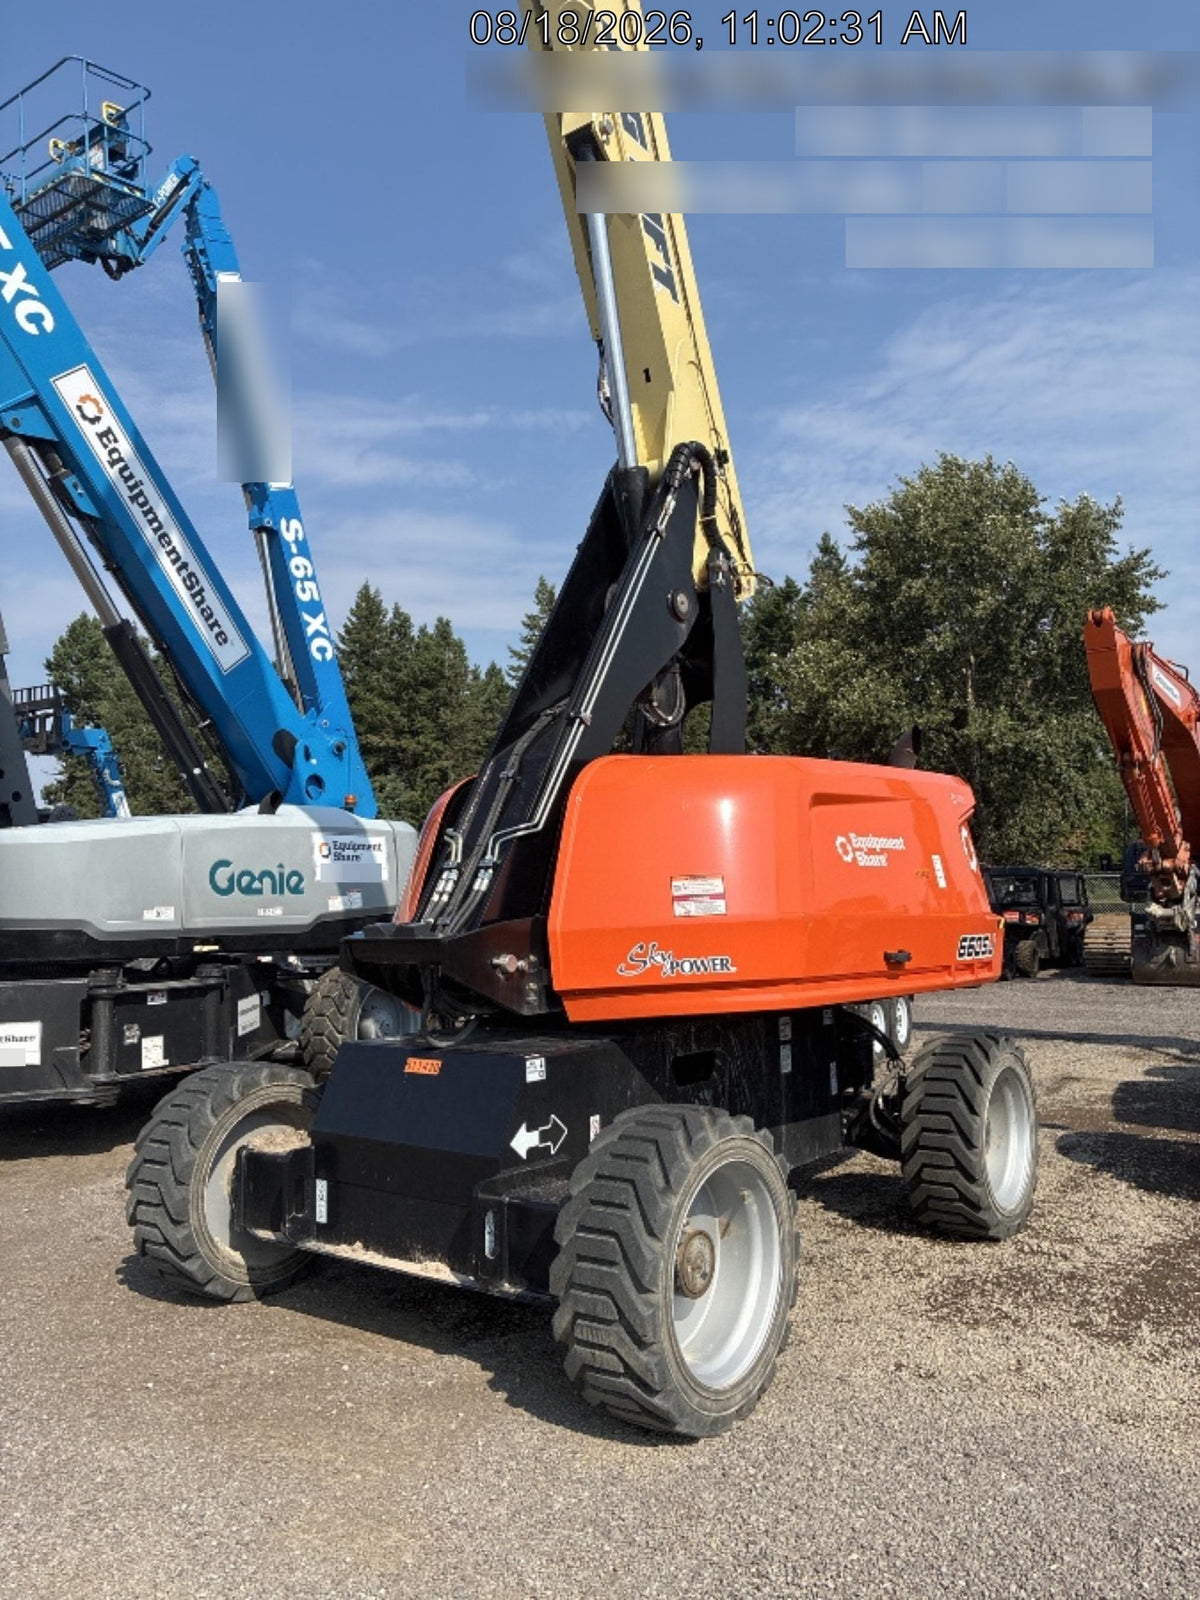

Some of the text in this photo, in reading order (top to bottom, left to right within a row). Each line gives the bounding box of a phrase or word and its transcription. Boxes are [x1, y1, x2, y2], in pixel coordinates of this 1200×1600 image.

[96, 426, 229, 647] EquipmentShare
[280, 517, 333, 662] S-65 XC
[332, 840, 383, 853] Equipment
[333, 852, 363, 862] Share
[209, 859, 305, 897] Genie
